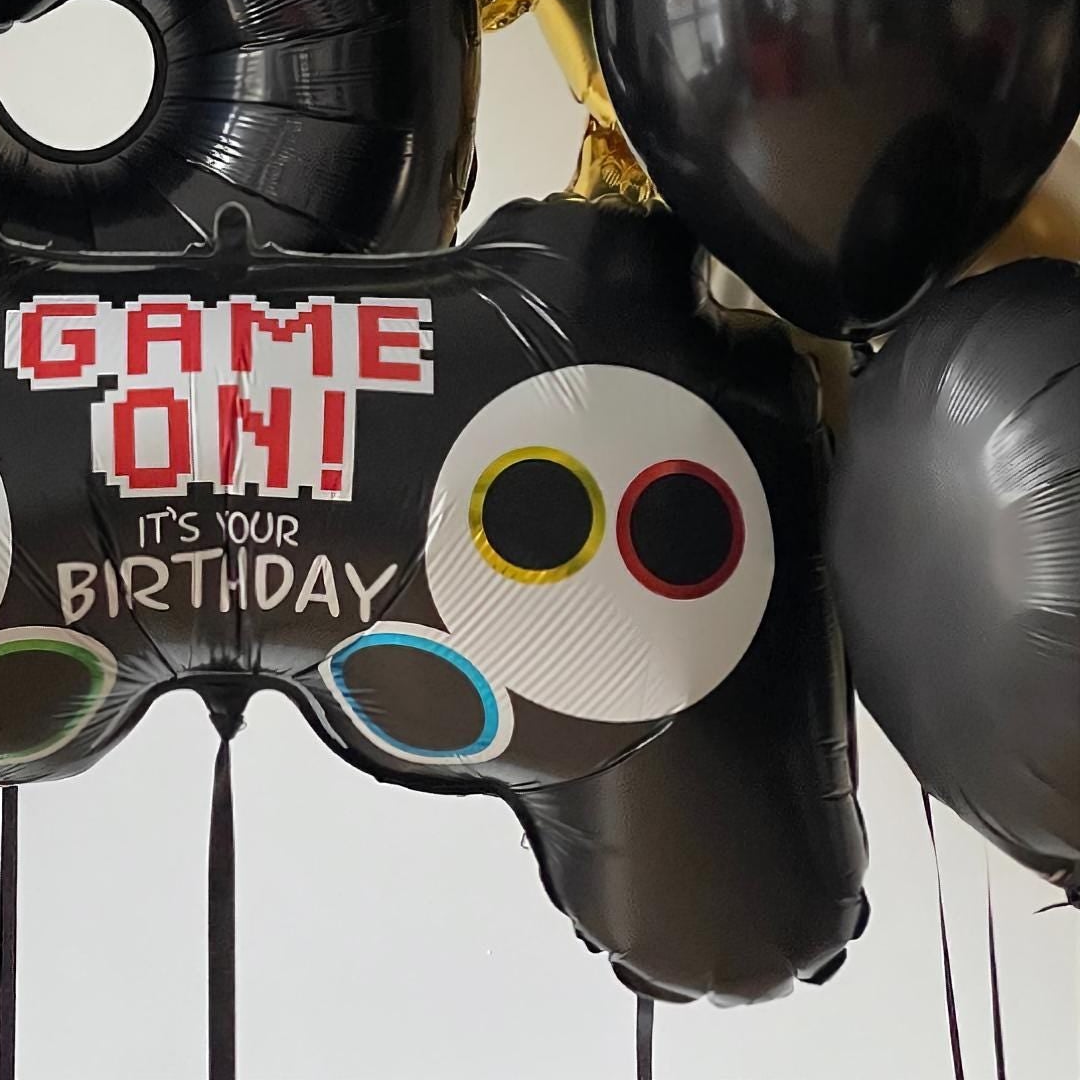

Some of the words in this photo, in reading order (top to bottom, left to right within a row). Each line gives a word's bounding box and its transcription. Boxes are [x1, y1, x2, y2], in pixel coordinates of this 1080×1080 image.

[18, 301, 423, 383] GAME
[111, 384, 346, 493] ON!
[138, 505, 200, 549] IT'S
[56, 546, 398, 625] BIRTHDAY
